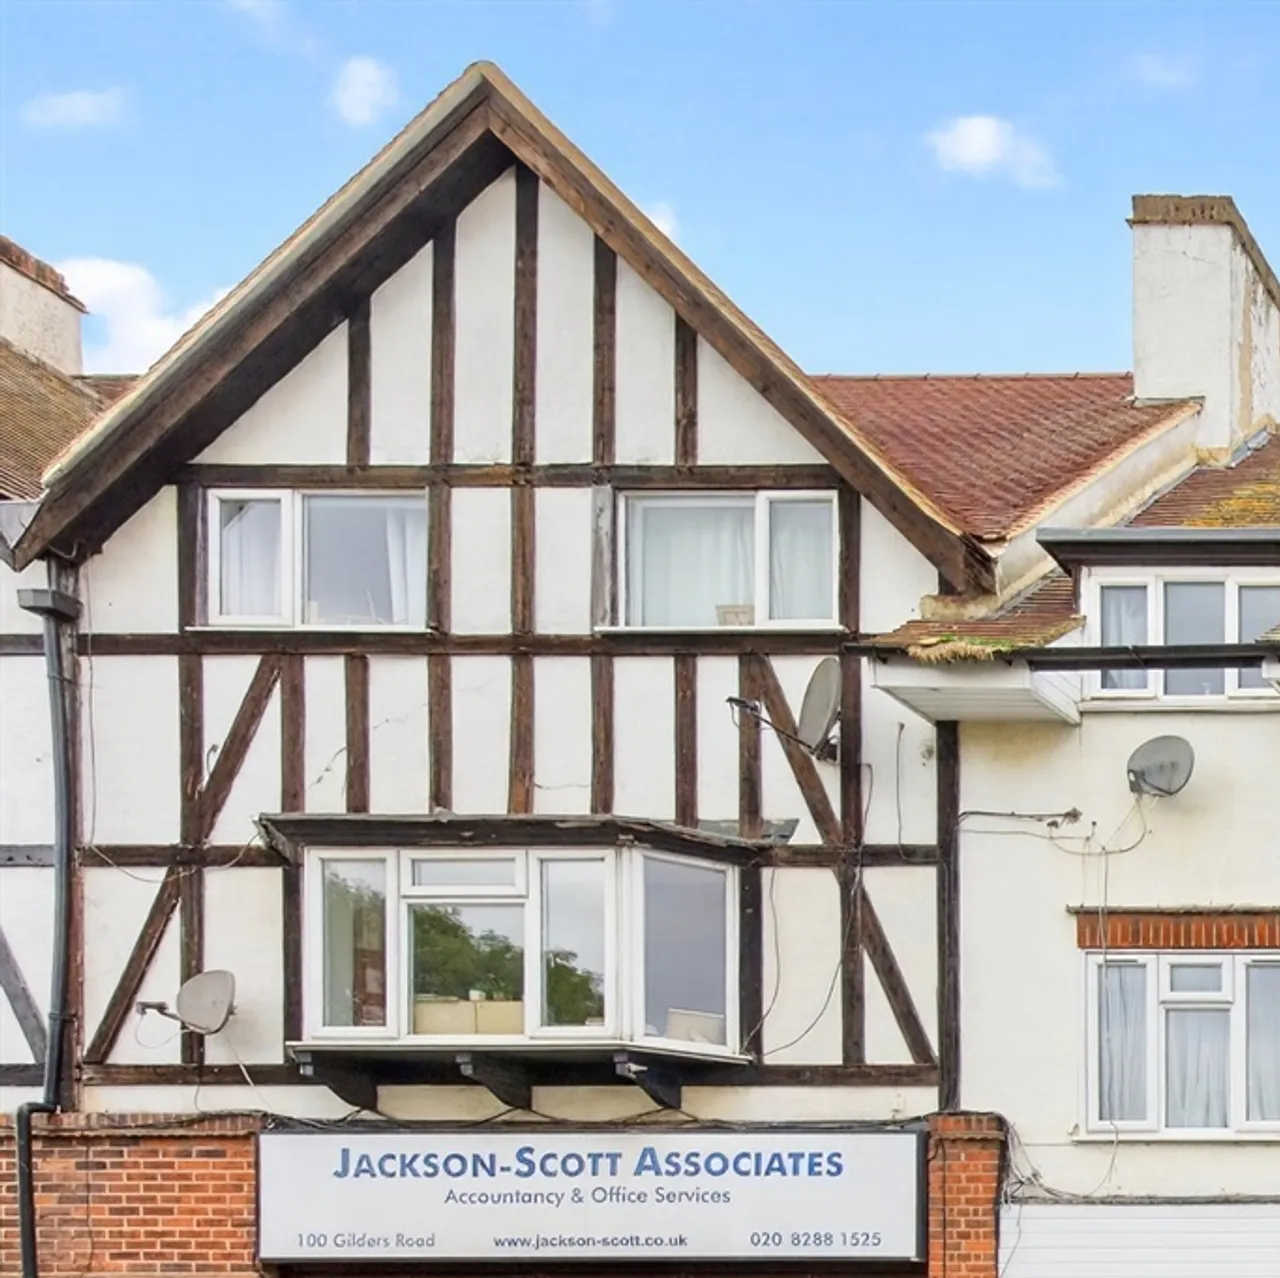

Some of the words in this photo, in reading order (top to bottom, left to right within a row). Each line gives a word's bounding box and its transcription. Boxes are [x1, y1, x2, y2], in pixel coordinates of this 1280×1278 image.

[633, 1146, 844, 1178] ASSOCIATES
[444, 1188, 565, 1208] Accountancy
[570, 1188, 584, 1204] &
[591, 1186, 648, 1204] Office
[655, 1186, 731, 1204] Services
[298, 1233, 328, 1248] 100
[333, 1232, 390, 1248] Gilders
[396, 1232, 435, 1248] Road
[493, 1233, 688, 1251] www.jackson-scott.co.uk
[750, 1231, 783, 1247] 020
[790, 1231, 834, 1247] 8288
[840, 1231, 882, 1247] 1525
